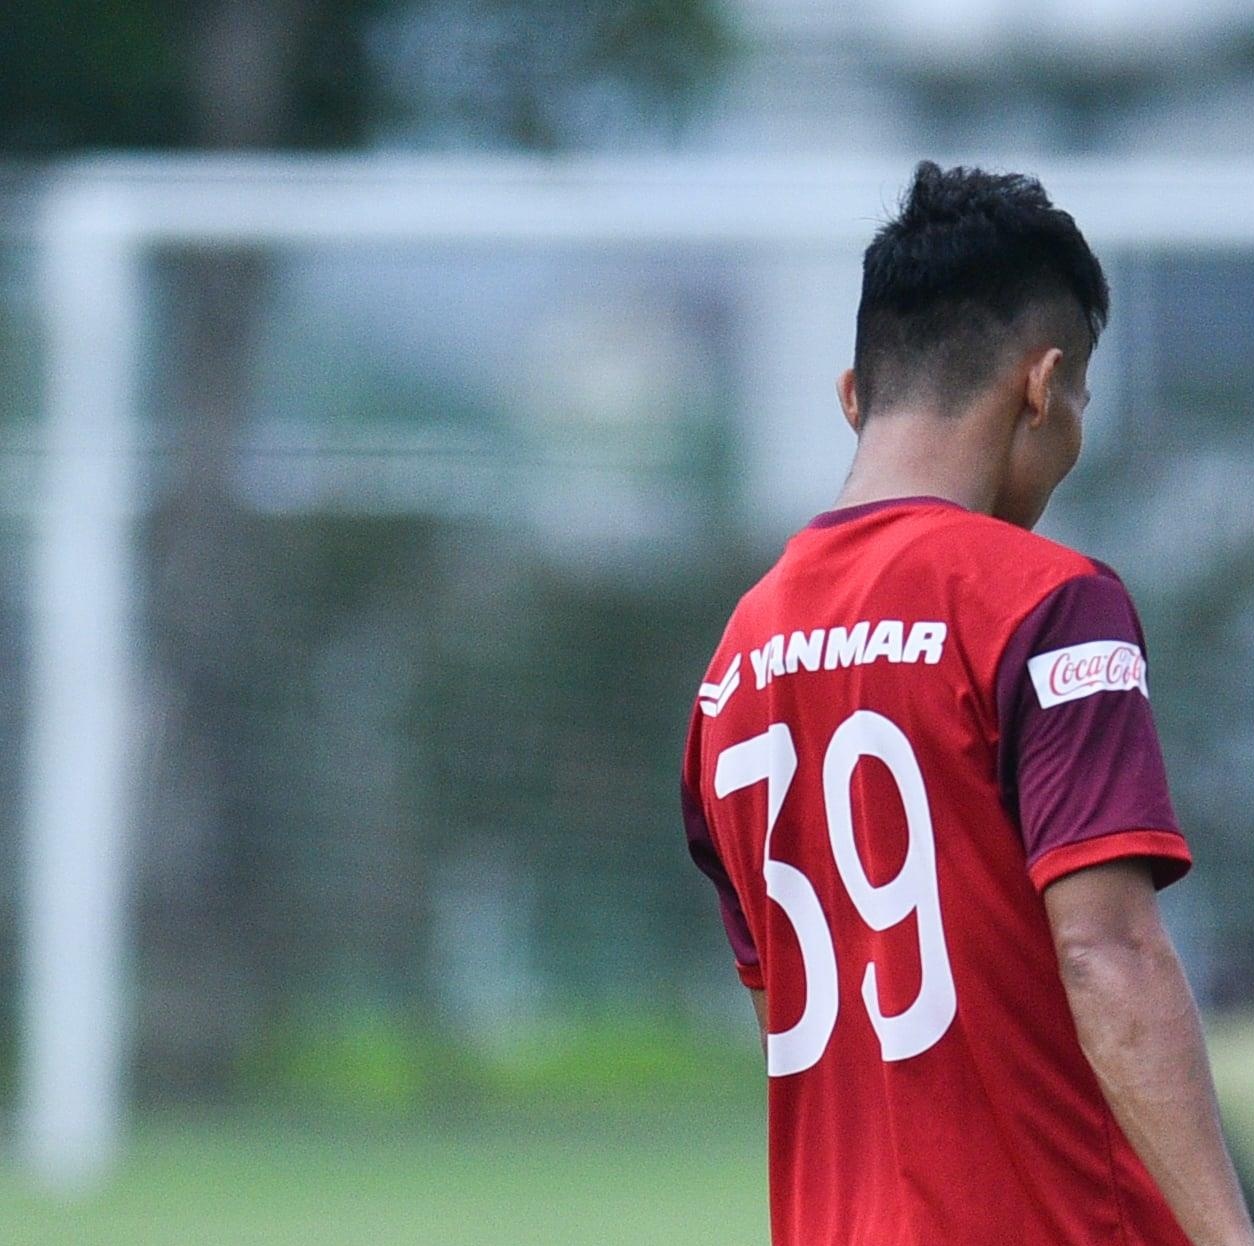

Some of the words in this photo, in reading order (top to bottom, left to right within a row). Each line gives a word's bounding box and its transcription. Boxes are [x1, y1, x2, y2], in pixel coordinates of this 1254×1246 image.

[750, 620, 947, 691] YANMAR
[1049, 646, 1143, 696] Coca-Col
[714, 710, 957, 1077] 39
